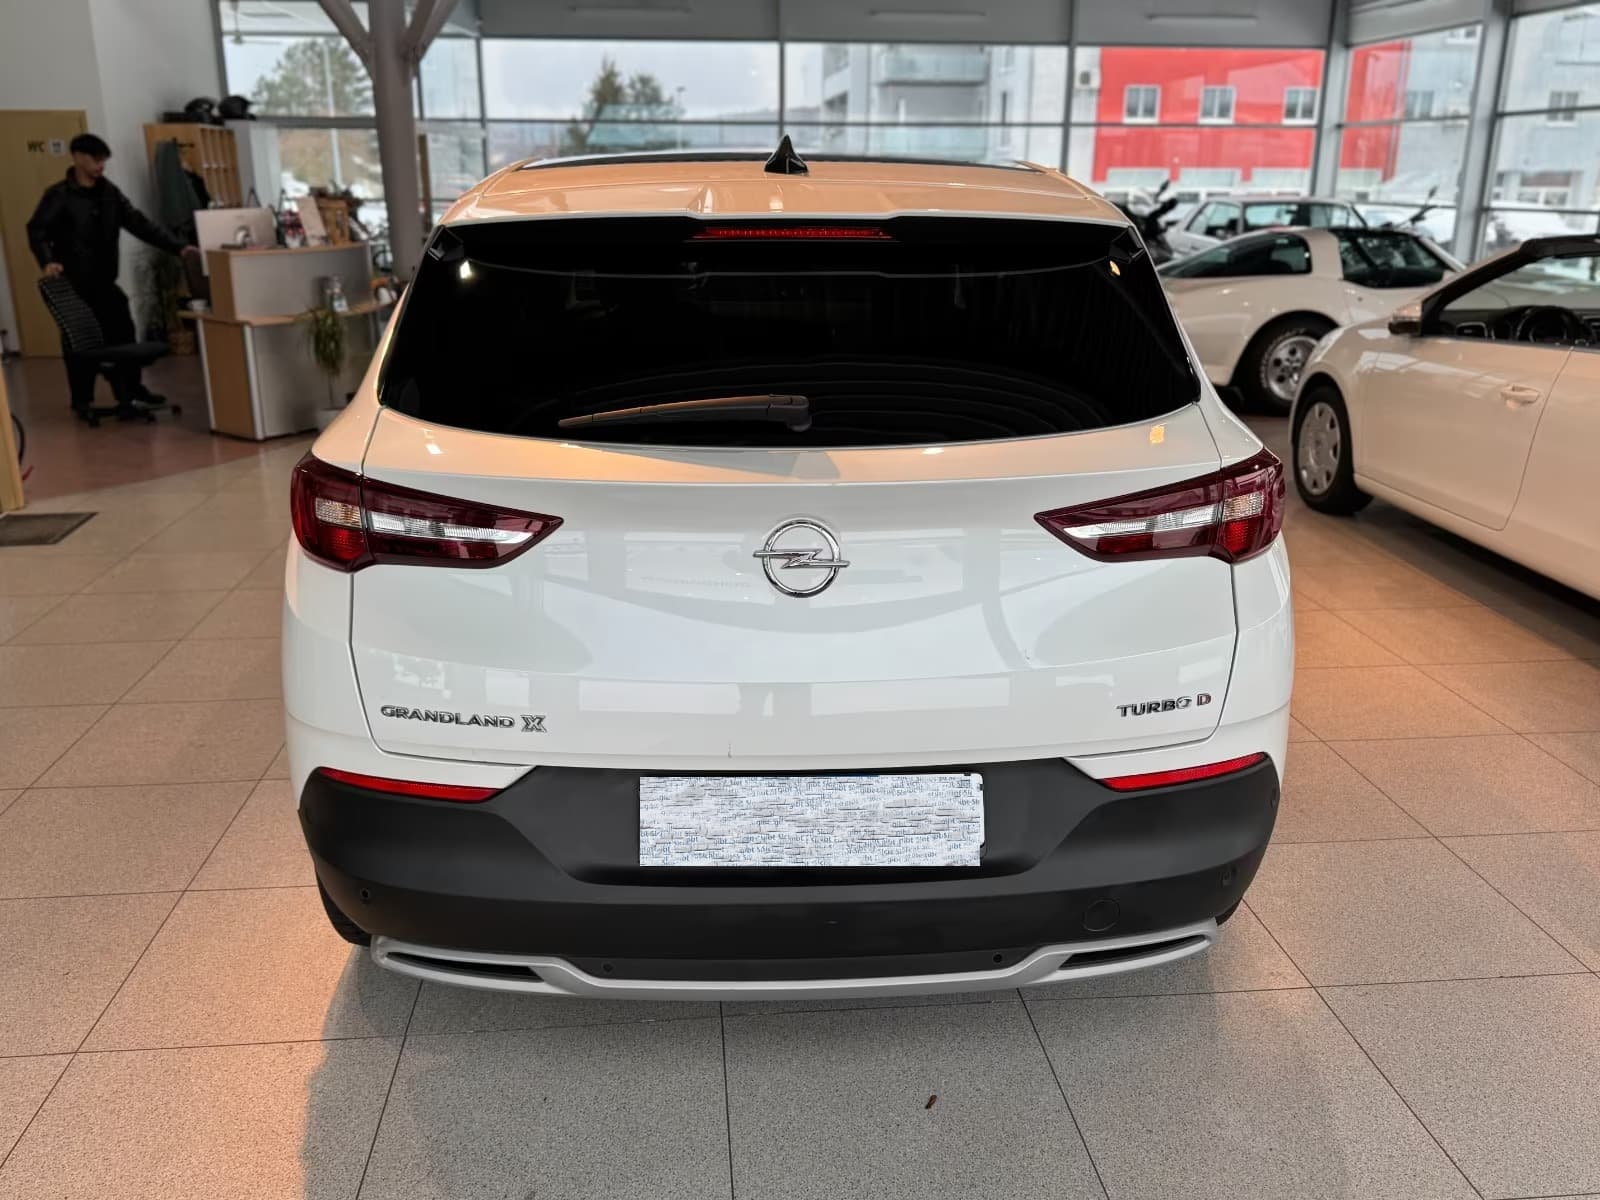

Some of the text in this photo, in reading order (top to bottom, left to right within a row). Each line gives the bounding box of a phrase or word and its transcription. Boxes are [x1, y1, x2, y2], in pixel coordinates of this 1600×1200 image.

[27, 140, 46, 153] WC
[1117, 693, 1211, 717] TURBO D
[381, 704, 547, 732] GRANDLAND X
